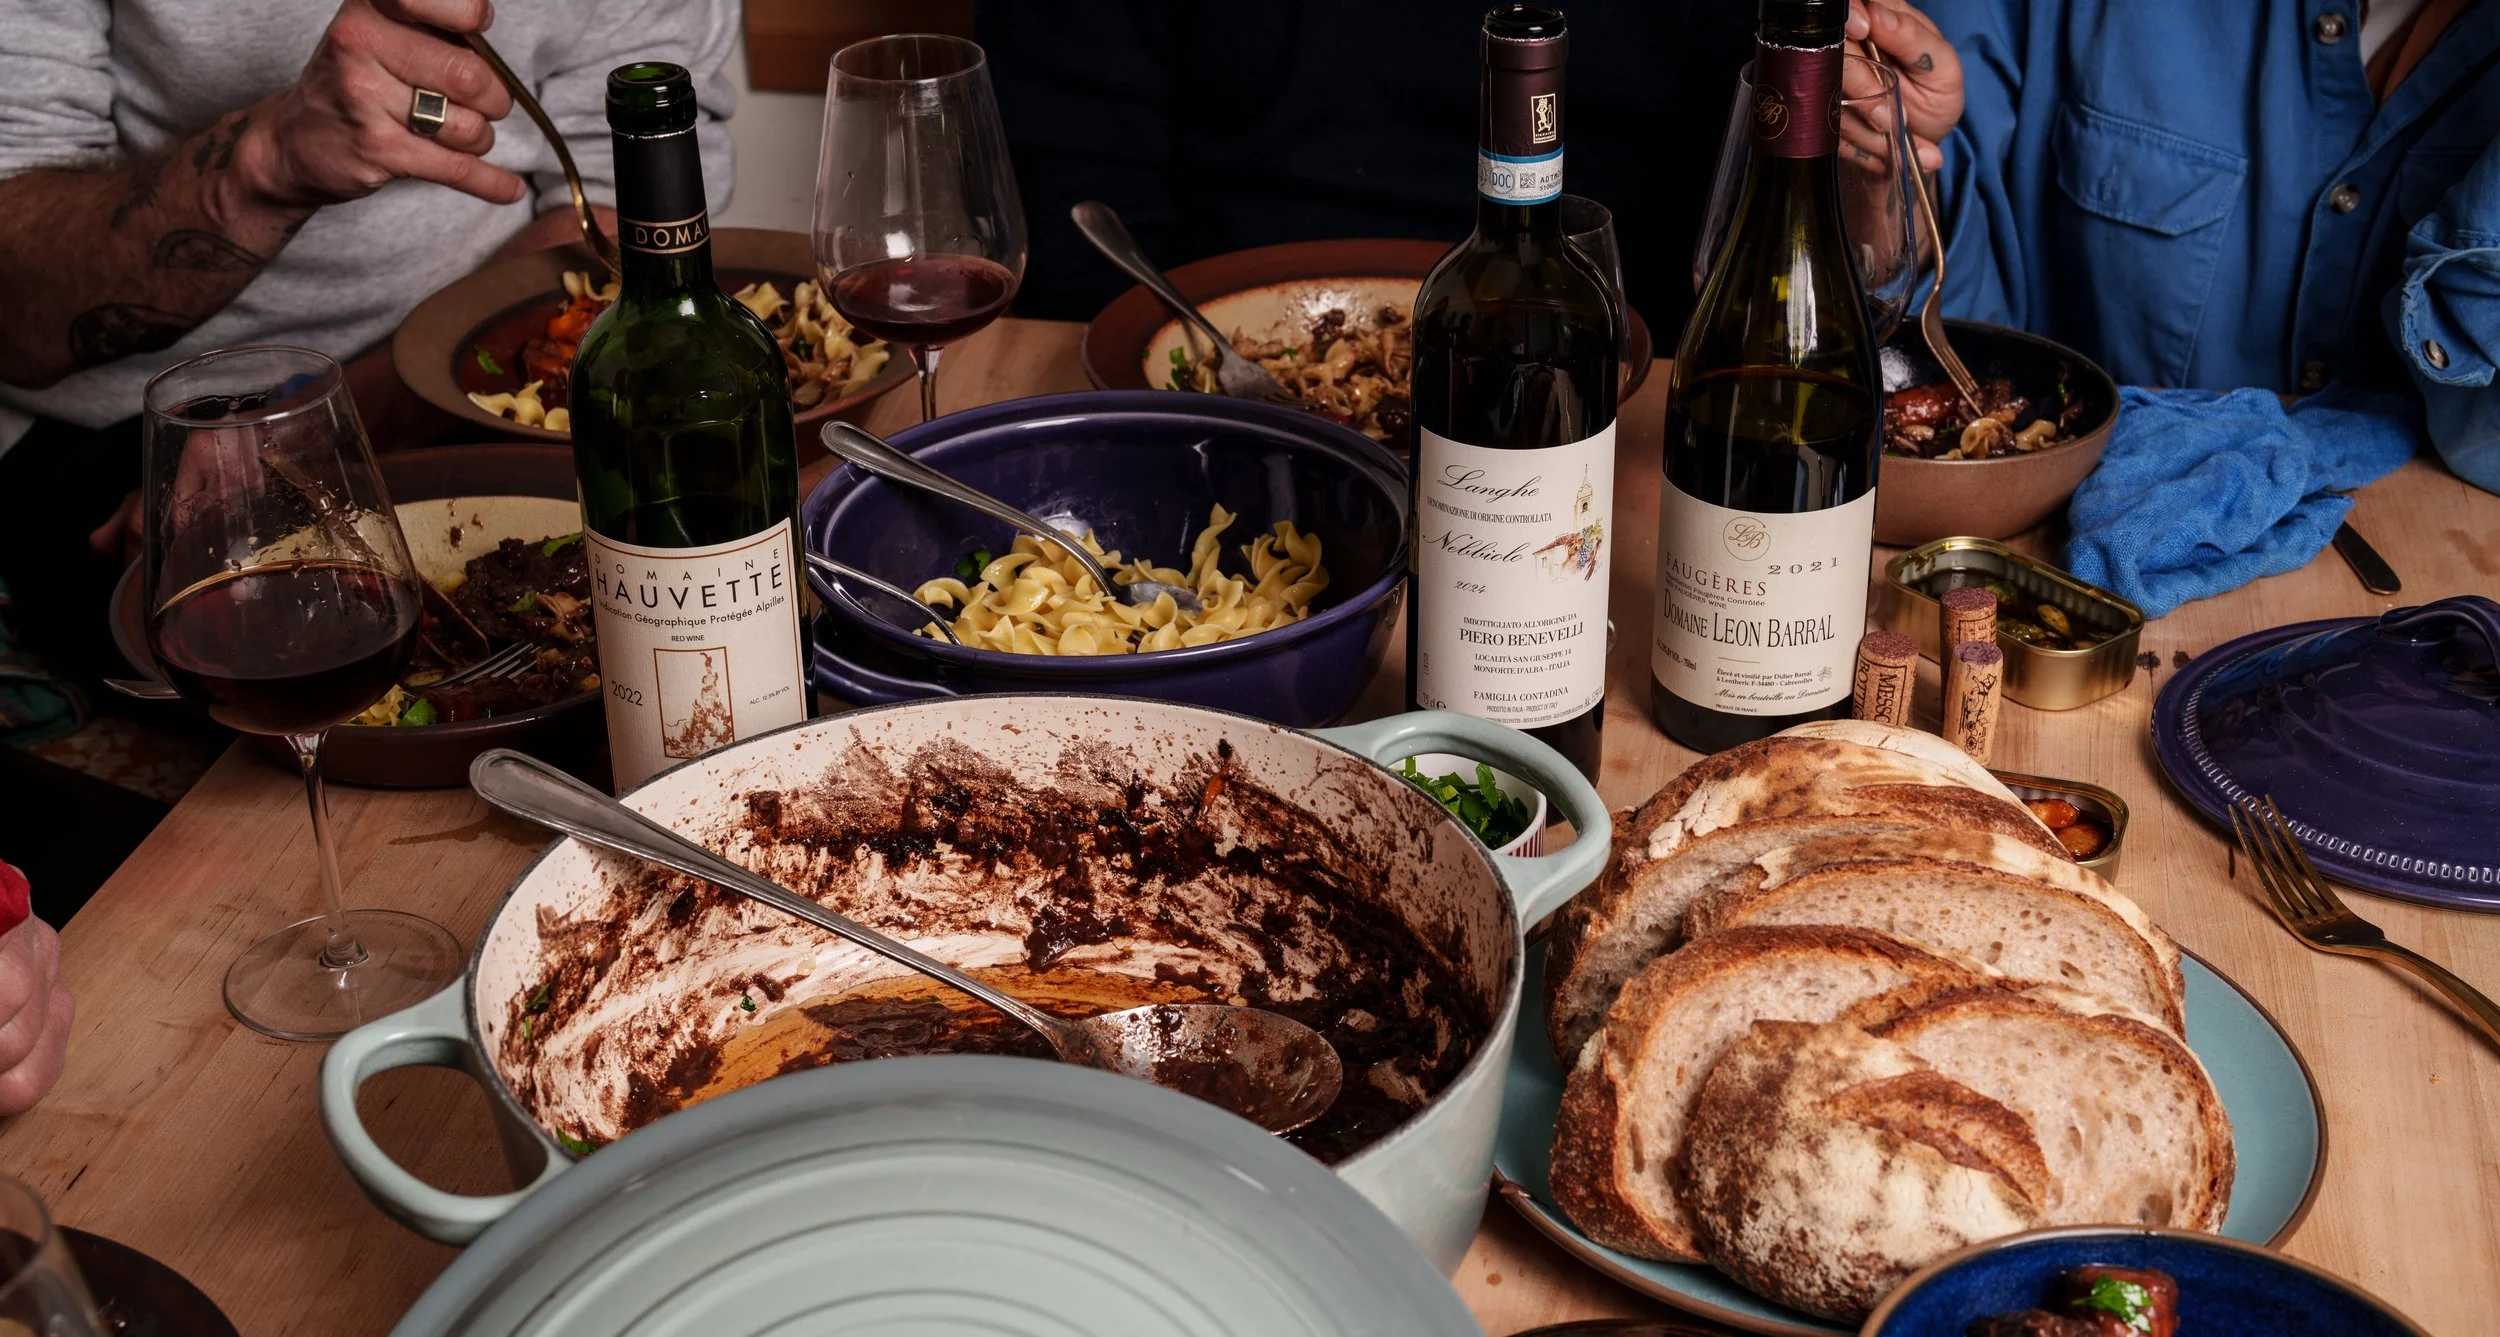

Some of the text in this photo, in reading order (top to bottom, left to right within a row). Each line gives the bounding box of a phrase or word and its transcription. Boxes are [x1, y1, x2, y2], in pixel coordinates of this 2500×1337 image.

[1493, 172, 1511, 188] DOC
[1437, 464, 1542, 503] Langhe
[1427, 496, 1552, 524] DENOMINAZIONE DI ORIGINE CONTROLLATA
[1423, 529, 1531, 563] Nebbiolo
[595, 548, 779, 581] DOMAINE
[1767, 556, 1839, 575] 2021
[1665, 551, 1767, 596] FAUGÈRES
[595, 563, 783, 610] HAUVETTE
[1454, 580, 1487, 594] 2024
[634, 613, 707, 628] Géographique
[710, 607, 753, 624] Protégée
[755, 595, 785, 615] Alpilles
[1708, 600, 1727, 609] WINE
[1463, 616, 1521, 629] IMBOTTIGLIATO
[1523, 615, 1567, 628] ALL'ORIGINE
[1663, 588, 1835, 648] DOMAINE LEON BARRAL
[686, 634, 705, 642] WINE
[1459, 621, 1584, 647] PIERO BENEVELLI
[1474, 648, 1572, 663] LOCALITÀ SAN GIUSEPPE 14
[1473, 664, 1516, 675] MONFORTE
[1517, 664, 1544, 675] D'ALBA
[1548, 660, 1571, 671] ITALIA
[1774, 672, 1793, 680] Didier
[1794, 670, 1812, 678] Barral
[611, 680, 643, 706] 2022
[1473, 690, 1517, 702] FAMIGLIA
[1519, 686, 1569, 701] CONTADINA
[1715, 688, 1735, 697] Mis
[1747, 691, 1784, 701] bouteille
[1796, 686, 1831, 699] Domaine
[1486, 705, 1506, 713] PRODOTTO
[1526, 704, 1543, 712] PRODUCT
